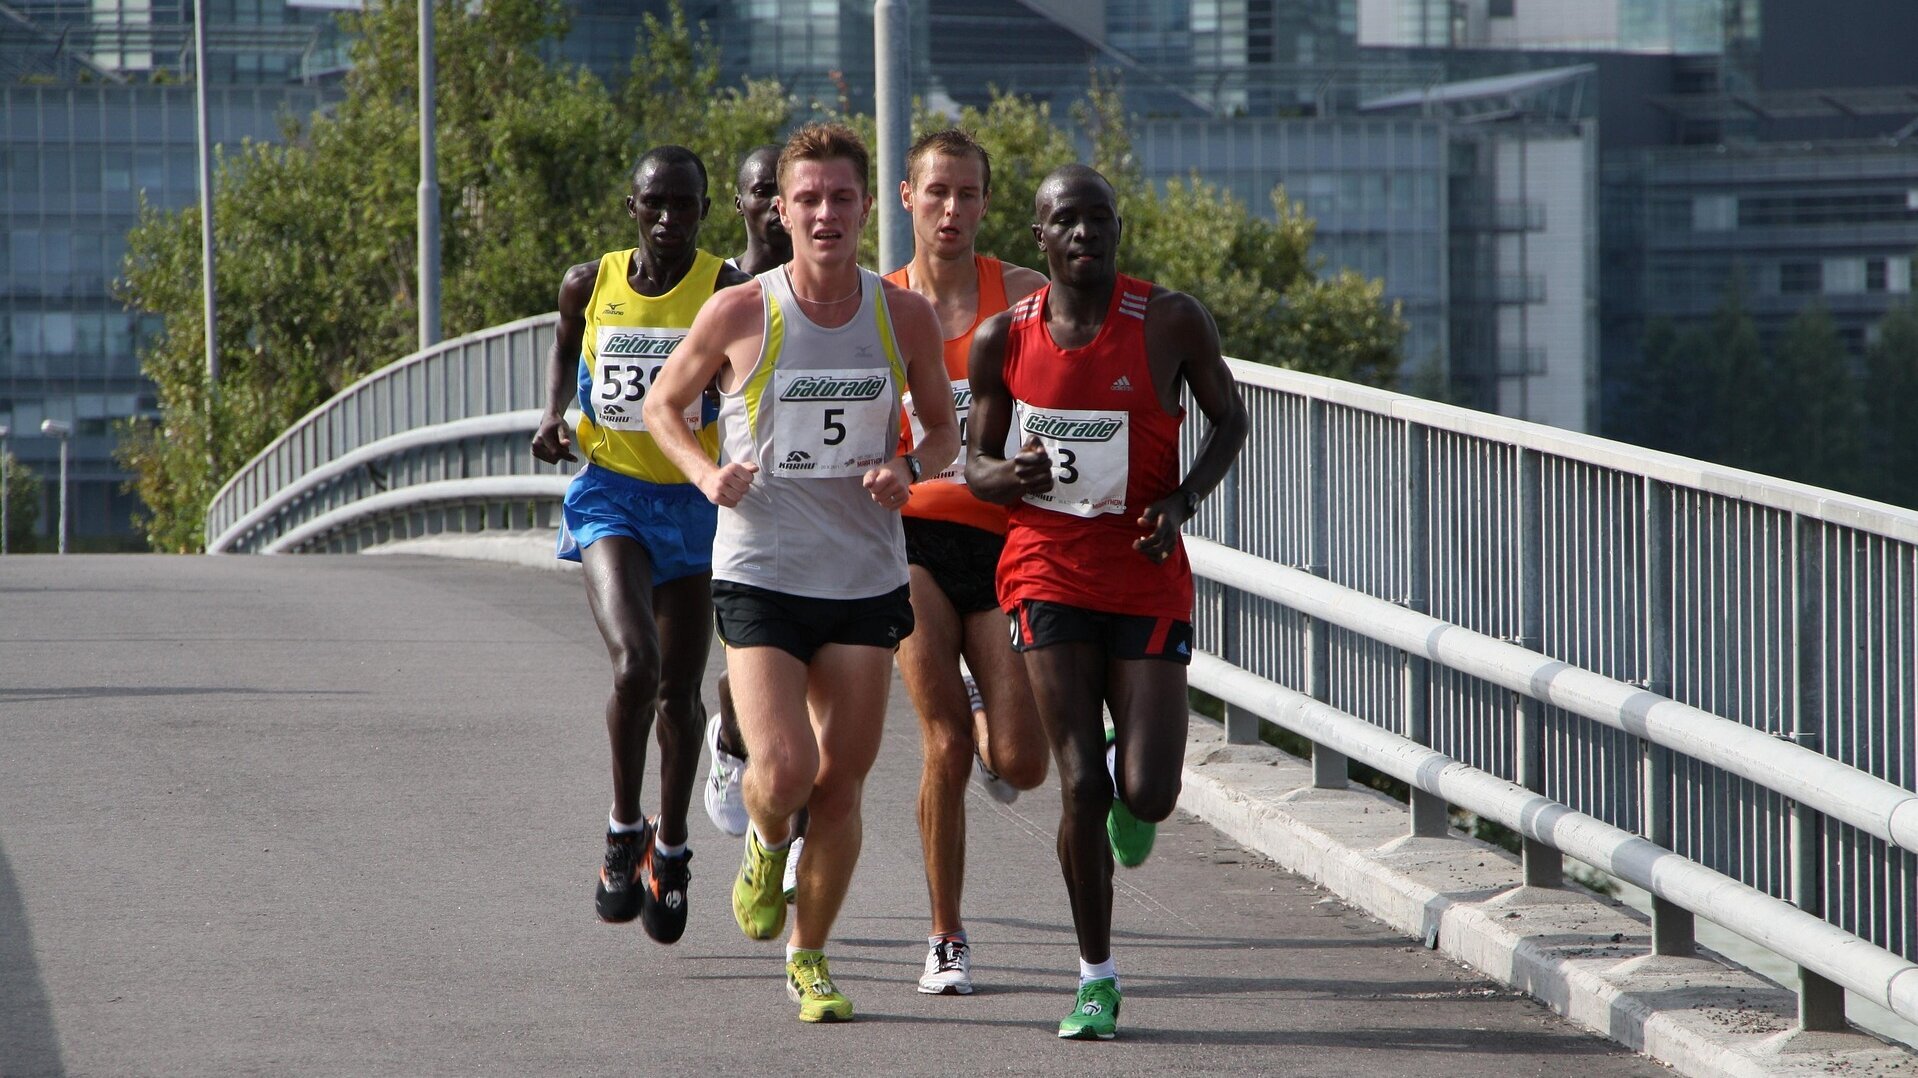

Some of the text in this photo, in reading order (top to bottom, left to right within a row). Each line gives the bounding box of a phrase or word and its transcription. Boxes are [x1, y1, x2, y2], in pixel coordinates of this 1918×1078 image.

[603, 336, 683, 354] Gatorad
[784, 379, 884, 398] Gatorade
[823, 408, 847, 446] 5
[1025, 415, 1116, 438] Gatorade
[778, 461, 817, 471] KARHU
[1058, 448, 1079, 485] 3
